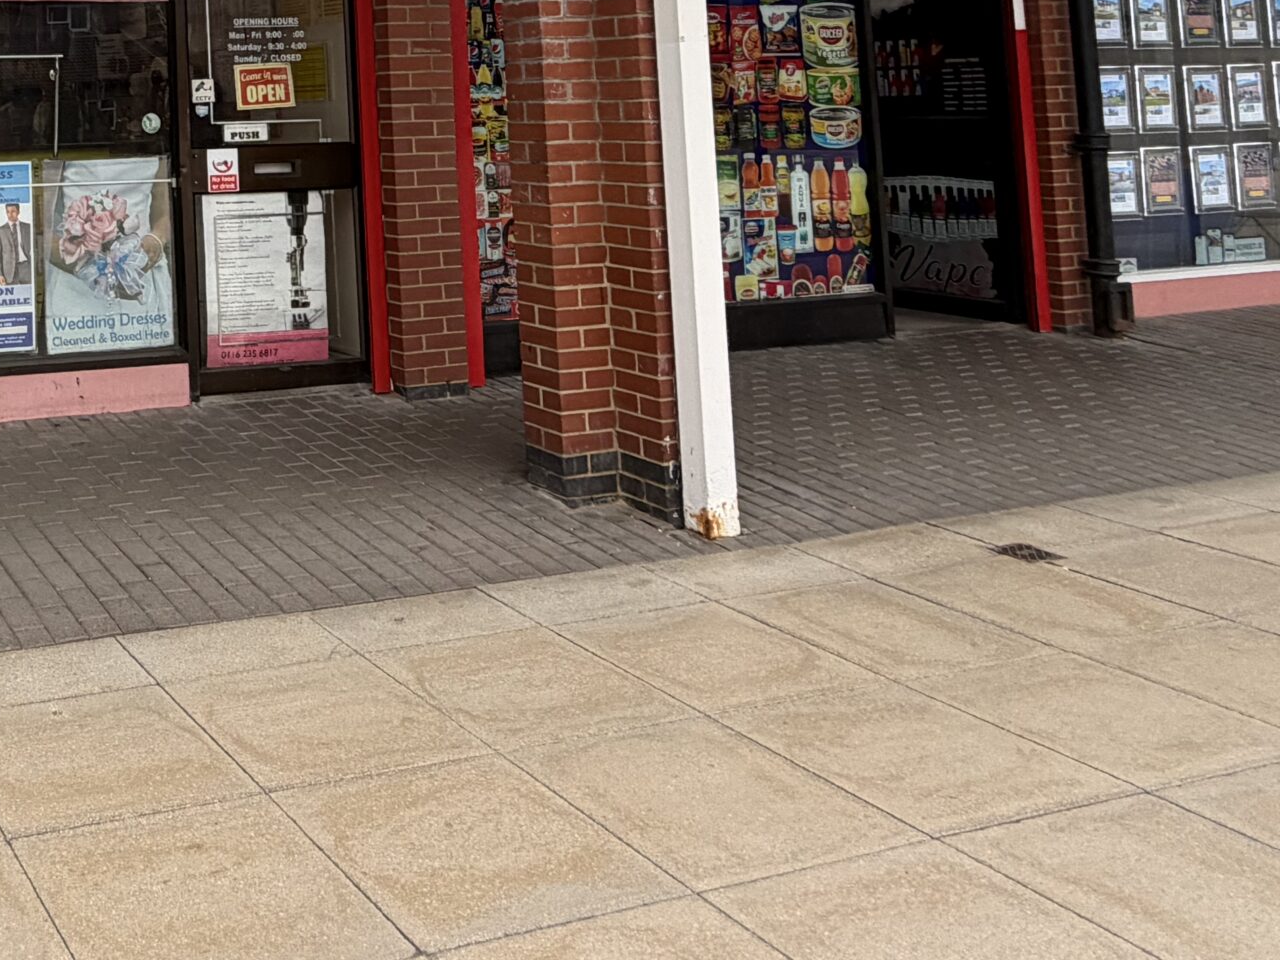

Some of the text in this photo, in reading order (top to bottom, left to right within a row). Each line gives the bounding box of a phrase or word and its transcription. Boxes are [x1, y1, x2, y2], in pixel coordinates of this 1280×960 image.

[233, 17, 299, 27] OPENING HOURS
[228, 31, 246, 39] Mon
[251, 31, 262, 39] Fri
[227, 43, 261, 52] Saturday
[234, 54, 302, 63] Sunday CLOSED
[241, 72, 262, 81] Come
[246, 83, 286, 103] OPEN
[230, 131, 260, 140] PUSH
[52, 312, 168, 332] Wedding Dresses
[52, 329, 170, 347] Cleaned & Boxed Here
[242, 349, 257, 358] 235
[259, 348, 279, 358] 6817
